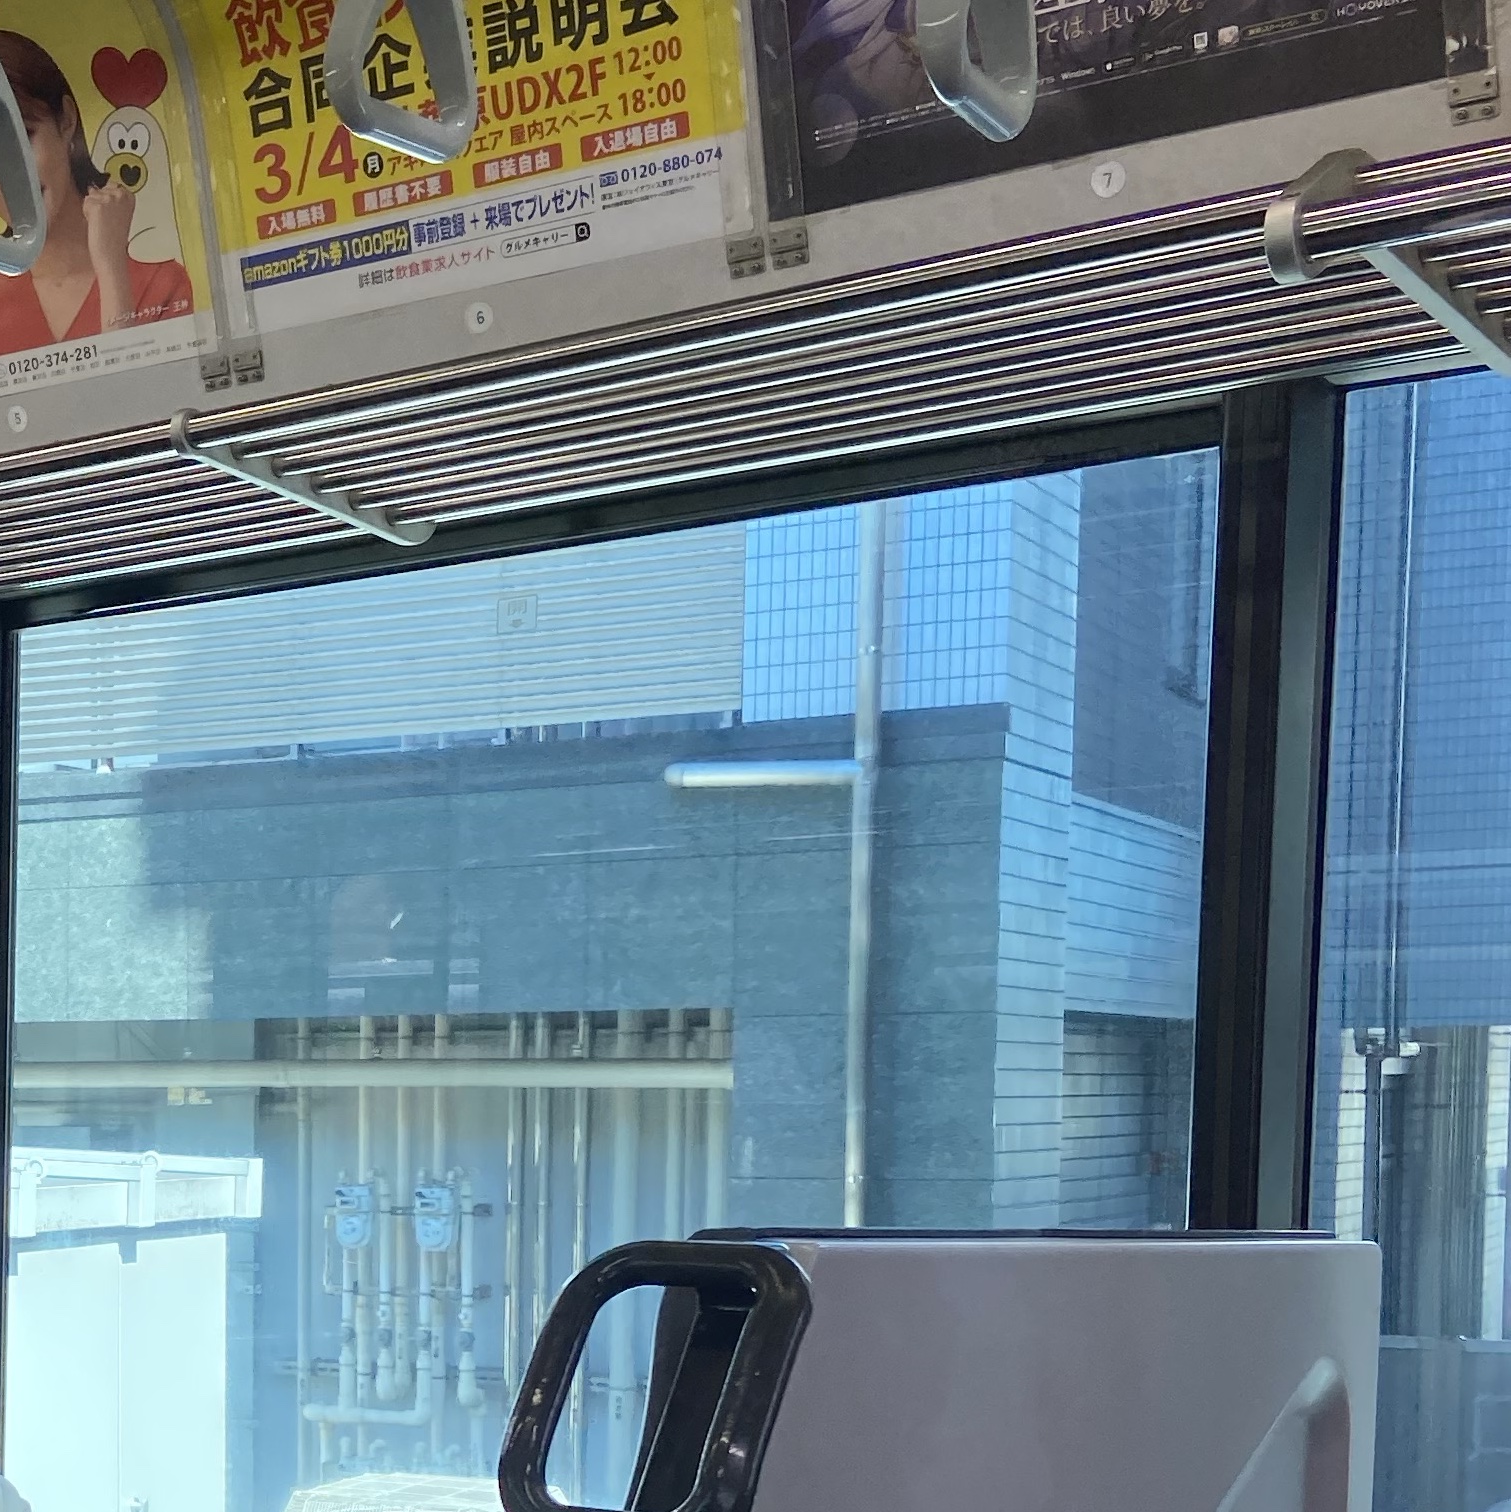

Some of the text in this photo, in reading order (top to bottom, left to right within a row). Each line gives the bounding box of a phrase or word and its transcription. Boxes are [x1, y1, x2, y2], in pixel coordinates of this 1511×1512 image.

[613, 36, 683, 76] 12:00
[618, 78, 687, 116] 18:00
[510, 103, 613, 147] 屋内スペース
[593, 118, 678, 157] 入退場自由
[253, 125, 382, 204] 3/4 月
[484, 150, 551, 184] 服装自由
[621, 146, 723, 182] 0120-880-074
[1102, 172, 1113, 188] 7
[363, 175, 442, 212] 履歴書不要
[267, 203, 326, 235] 入場無料
[476, 310, 485, 325] 6
[8, 344, 98, 376] 0120-374-281
[14, 412, 22, 425] 5
